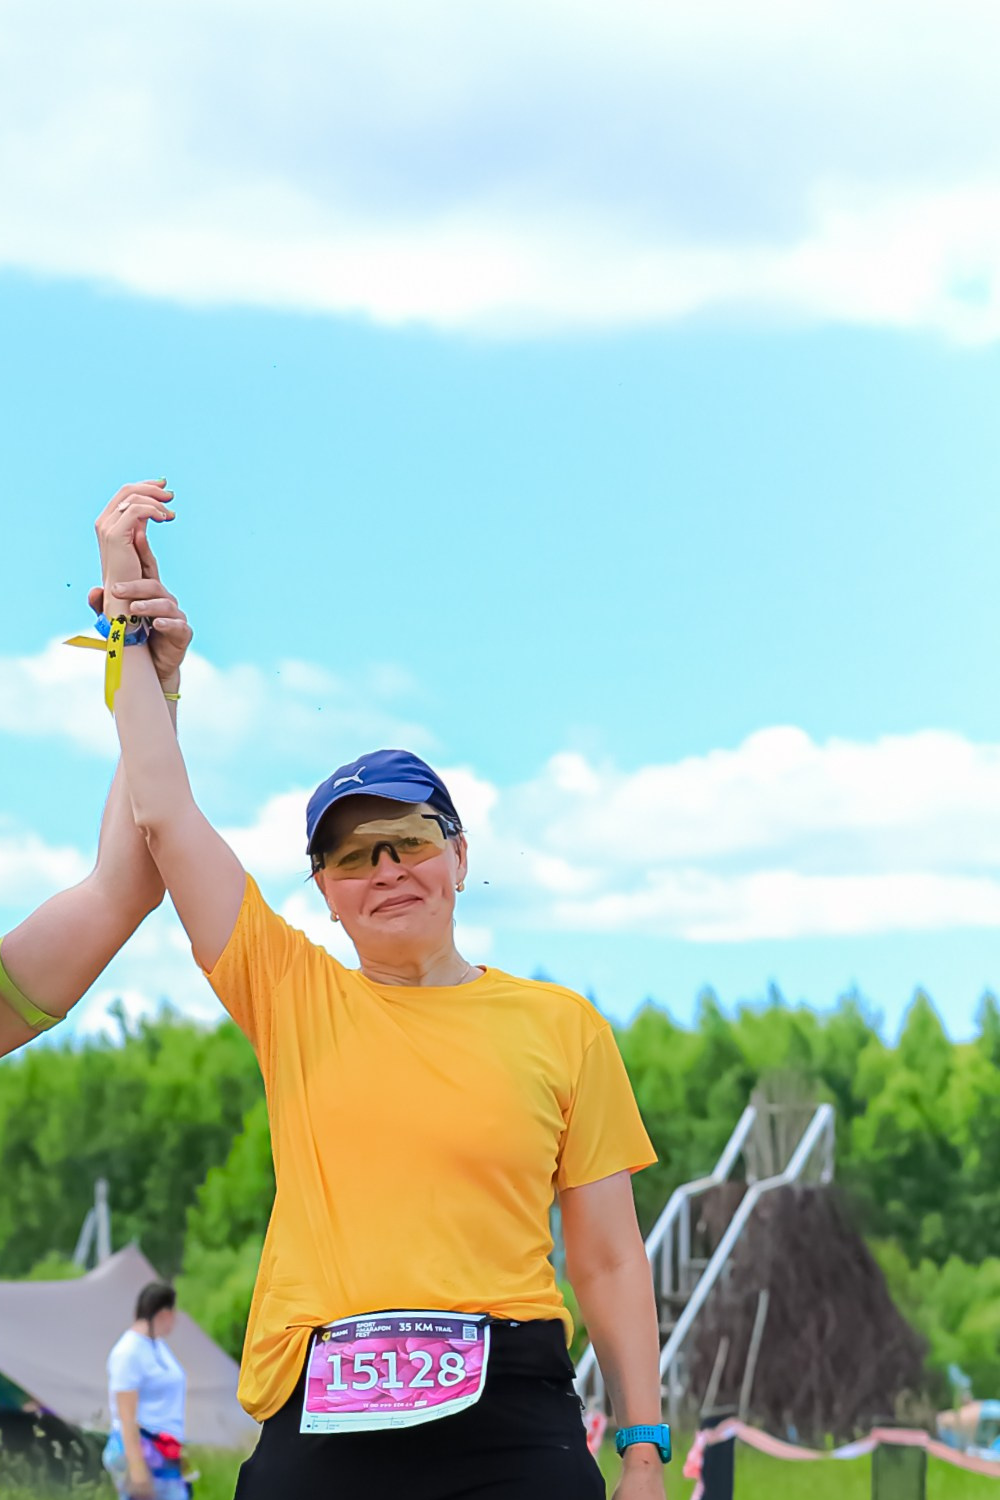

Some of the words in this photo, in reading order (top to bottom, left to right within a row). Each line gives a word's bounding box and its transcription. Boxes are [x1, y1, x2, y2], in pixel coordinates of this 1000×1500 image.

[399, 1323, 411, 1331] 35
[415, 1323, 432, 1331] KM
[332, 1329, 348, 1337] BANK
[325, 1350, 466, 1391] 15128
